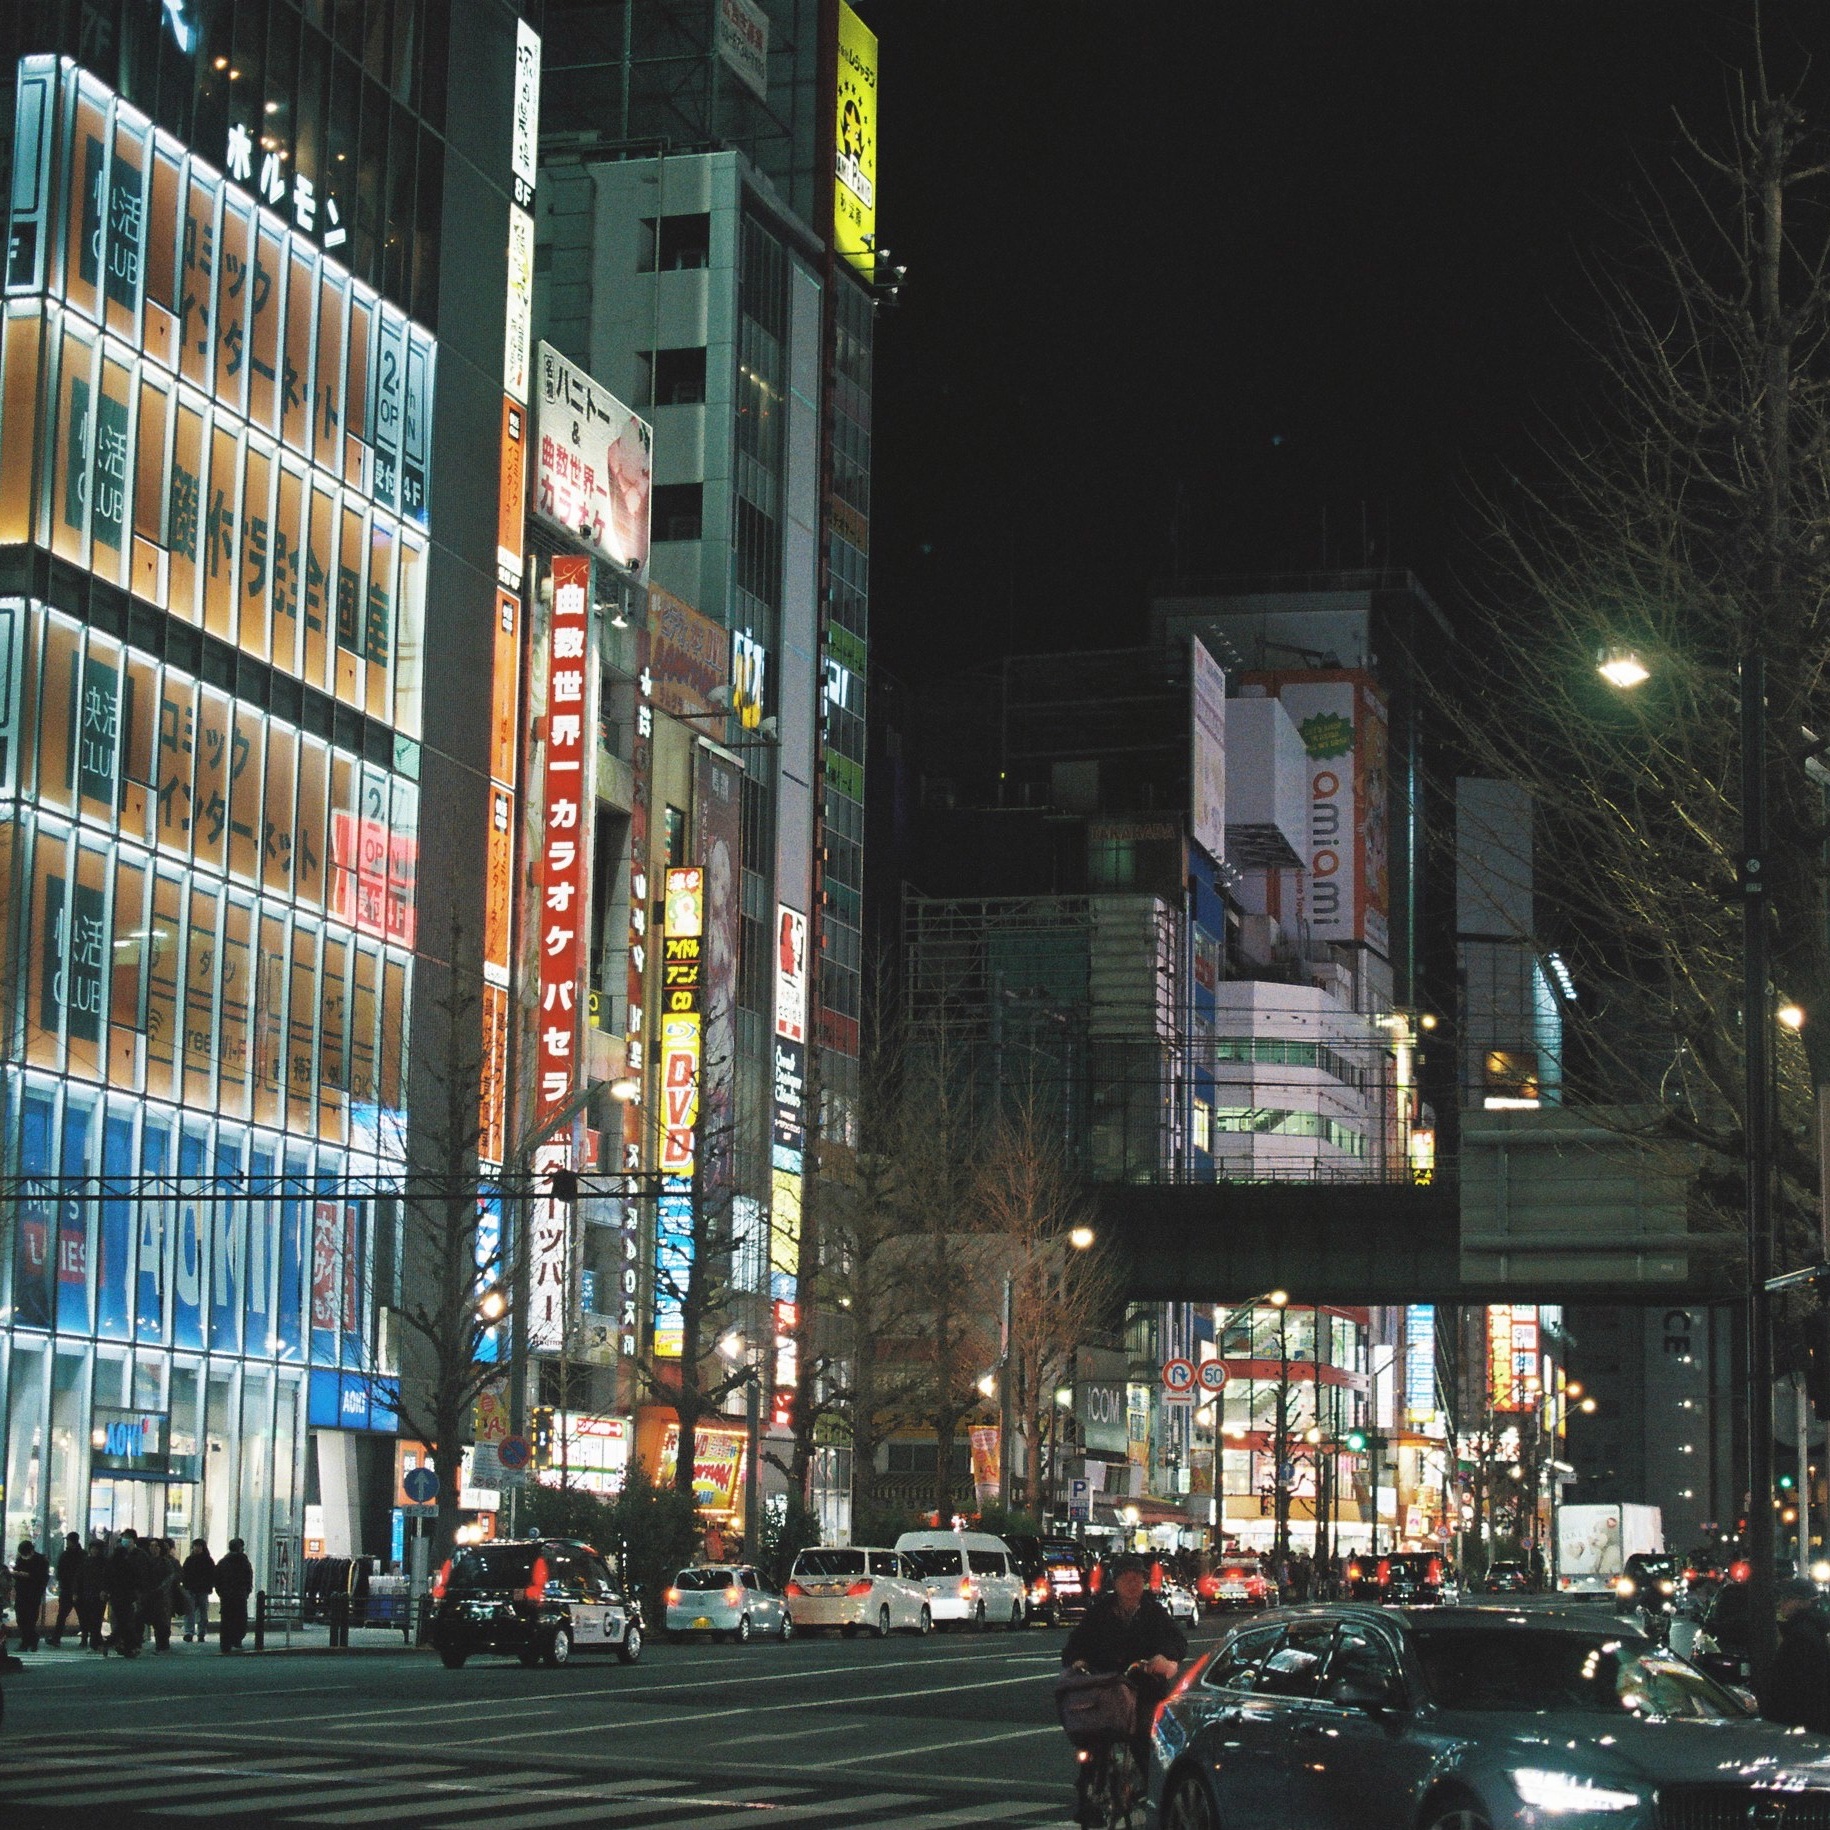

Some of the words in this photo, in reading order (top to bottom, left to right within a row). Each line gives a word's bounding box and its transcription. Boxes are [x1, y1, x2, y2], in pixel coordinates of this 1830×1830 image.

[227, 123, 347, 248] ホルモン
[514, 177, 532, 206] 8F
[571, 420, 581, 448] &
[542, 434, 608, 499] 曲数世界一
[540, 473, 606, 548] カラオケ
[159, 698, 252, 781] コミック
[157, 773, 319, 882] インターネット
[542, 583, 586, 1102] 曲数世界一カラオケパセラ
[1312, 770, 1340, 925] amiami
[666, 938, 700, 960] アイドル
[666, 965, 698, 986] アニメ
[671, 991, 693, 1011] CD
[664, 1051, 697, 1165] DVD
[1204, 1367, 1223, 1384] 50
[343, 1391, 367, 1414] AOKI
[1087, 1386, 1120, 1425] ICOM
[105, 1422, 143, 1458] AOKI
[1073, 1480, 1087, 1498] P
[1214, 1591, 1249, 1600] POLICE
